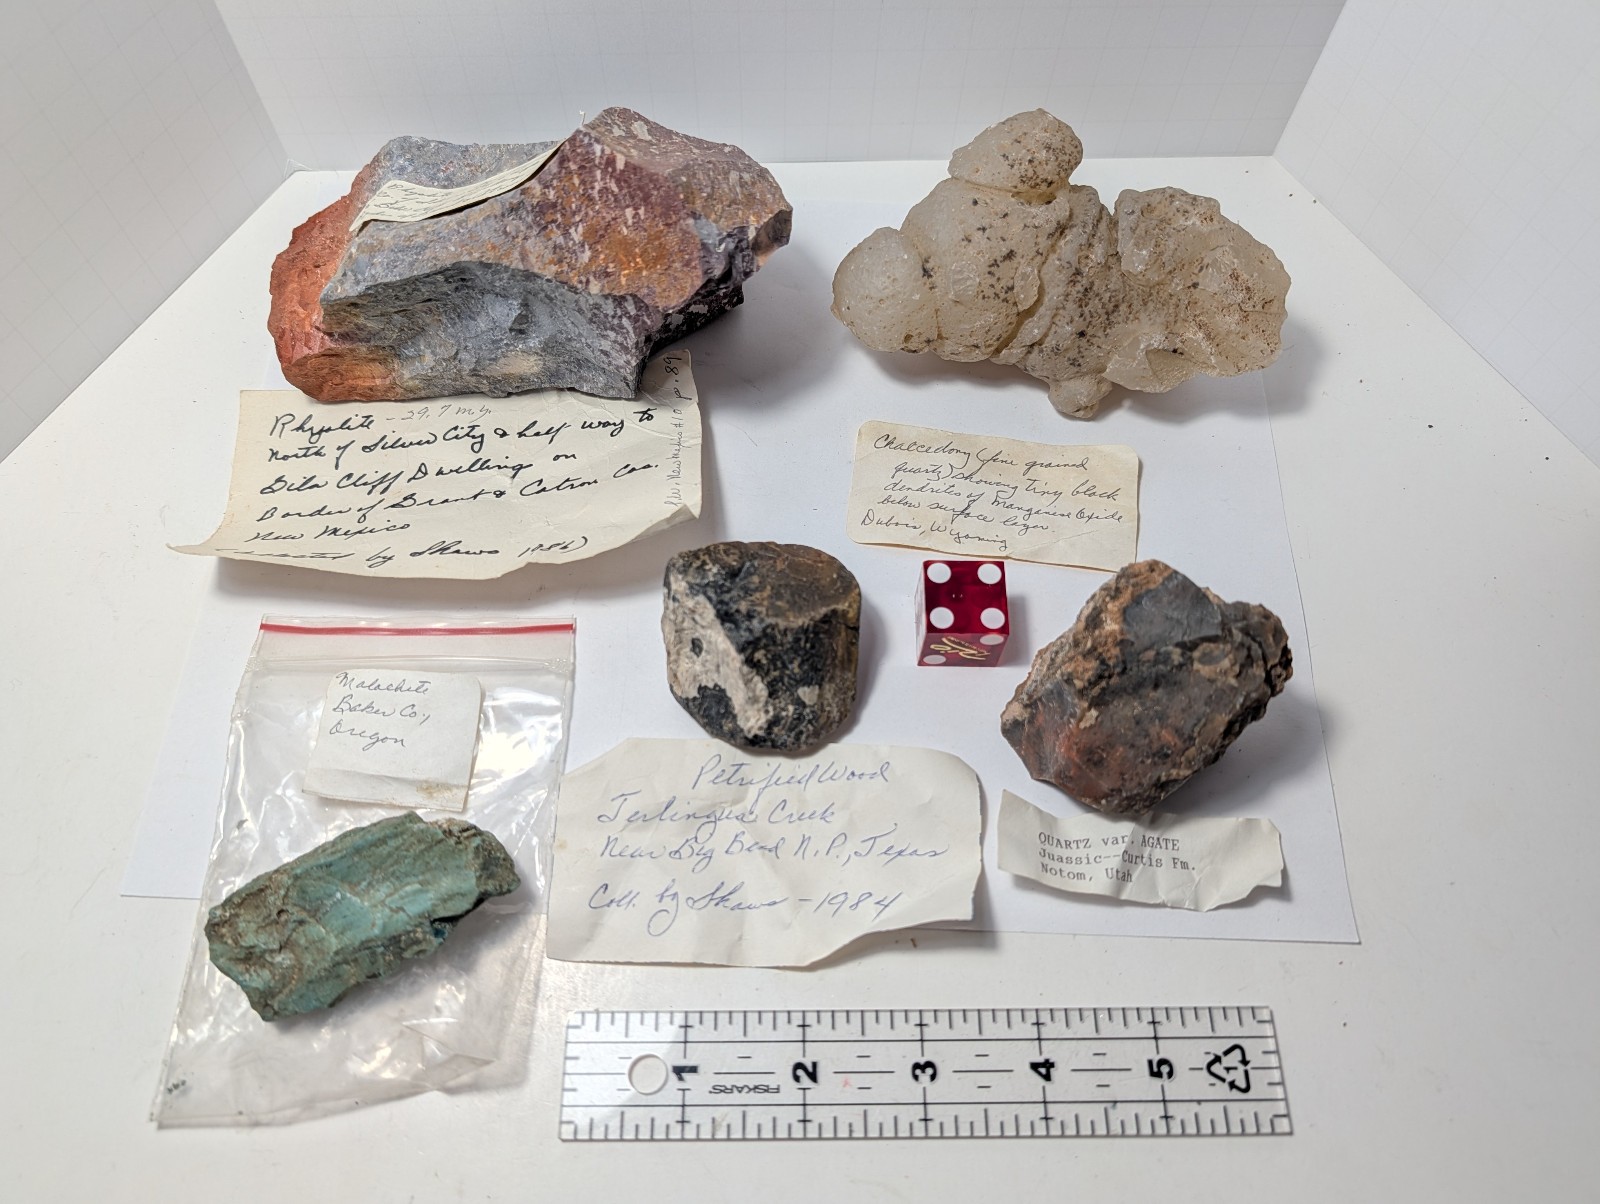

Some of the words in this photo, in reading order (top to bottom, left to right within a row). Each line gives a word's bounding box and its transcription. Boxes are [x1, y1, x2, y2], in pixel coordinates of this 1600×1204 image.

[663, 356, 682, 376] 89
[269, 413, 375, 444] Rhyolite
[335, 439, 355, 470] of
[361, 430, 438, 454] Silver
[442, 423, 486, 454] City
[493, 426, 512, 439] &
[516, 420, 573, 445] half
[580, 418, 625, 438] way
[633, 407, 658, 423] to
[873, 433, 972, 468] Chalcedony
[1024, 456, 1090, 476] grained
[336, 469, 404, 496] Cliff
[552, 452, 577, 462] on
[951, 471, 1020, 499] showing
[1070, 479, 1121, 502] black
[256, 506, 352, 523] Border
[356, 497, 386, 524] of
[492, 488, 507, 499] &
[519, 478, 599, 497] Catron
[877, 493, 921, 509] below
[926, 500, 995, 525] surface
[883, 479, 962, 498] dendrites
[964, 490, 986, 512] of
[860, 509, 926, 537] Dubois,
[929, 522, 1008, 552] Wyoming
[365, 546, 395, 569] by
[335, 671, 432, 696] Malachite
[332, 693, 396, 718] Baker
[329, 718, 407, 752] Oregon
[691, 752, 820, 811] Petrified
[818, 759, 890, 787] Wood
[597, 790, 759, 845] Terlingua
[765, 799, 836, 826] Creek
[600, 833, 667, 860] Near
[668, 833, 714, 874] Big
[724, 830, 786, 858] Bend
[853, 822, 951, 867] Texas
[1037, 831, 1091, 850] QUARTZ
[1101, 833, 1136, 847] var.
[1140, 834, 1181, 852] AGATE
[1039, 863, 1095, 883] Notom,
[1104, 866, 1134, 883] Utah
[1171, 858, 1197, 872] Fm.
[647, 878, 682, 937] by
[670, 1064, 699, 1082] 1
[791, 1060, 820, 1084] 2
[911, 1060, 938, 1083] 3
[1029, 1060, 1056, 1083] 4
[1147, 1057, 1174, 1081] 5
[708, 1083, 781, 1095] FISKARS
